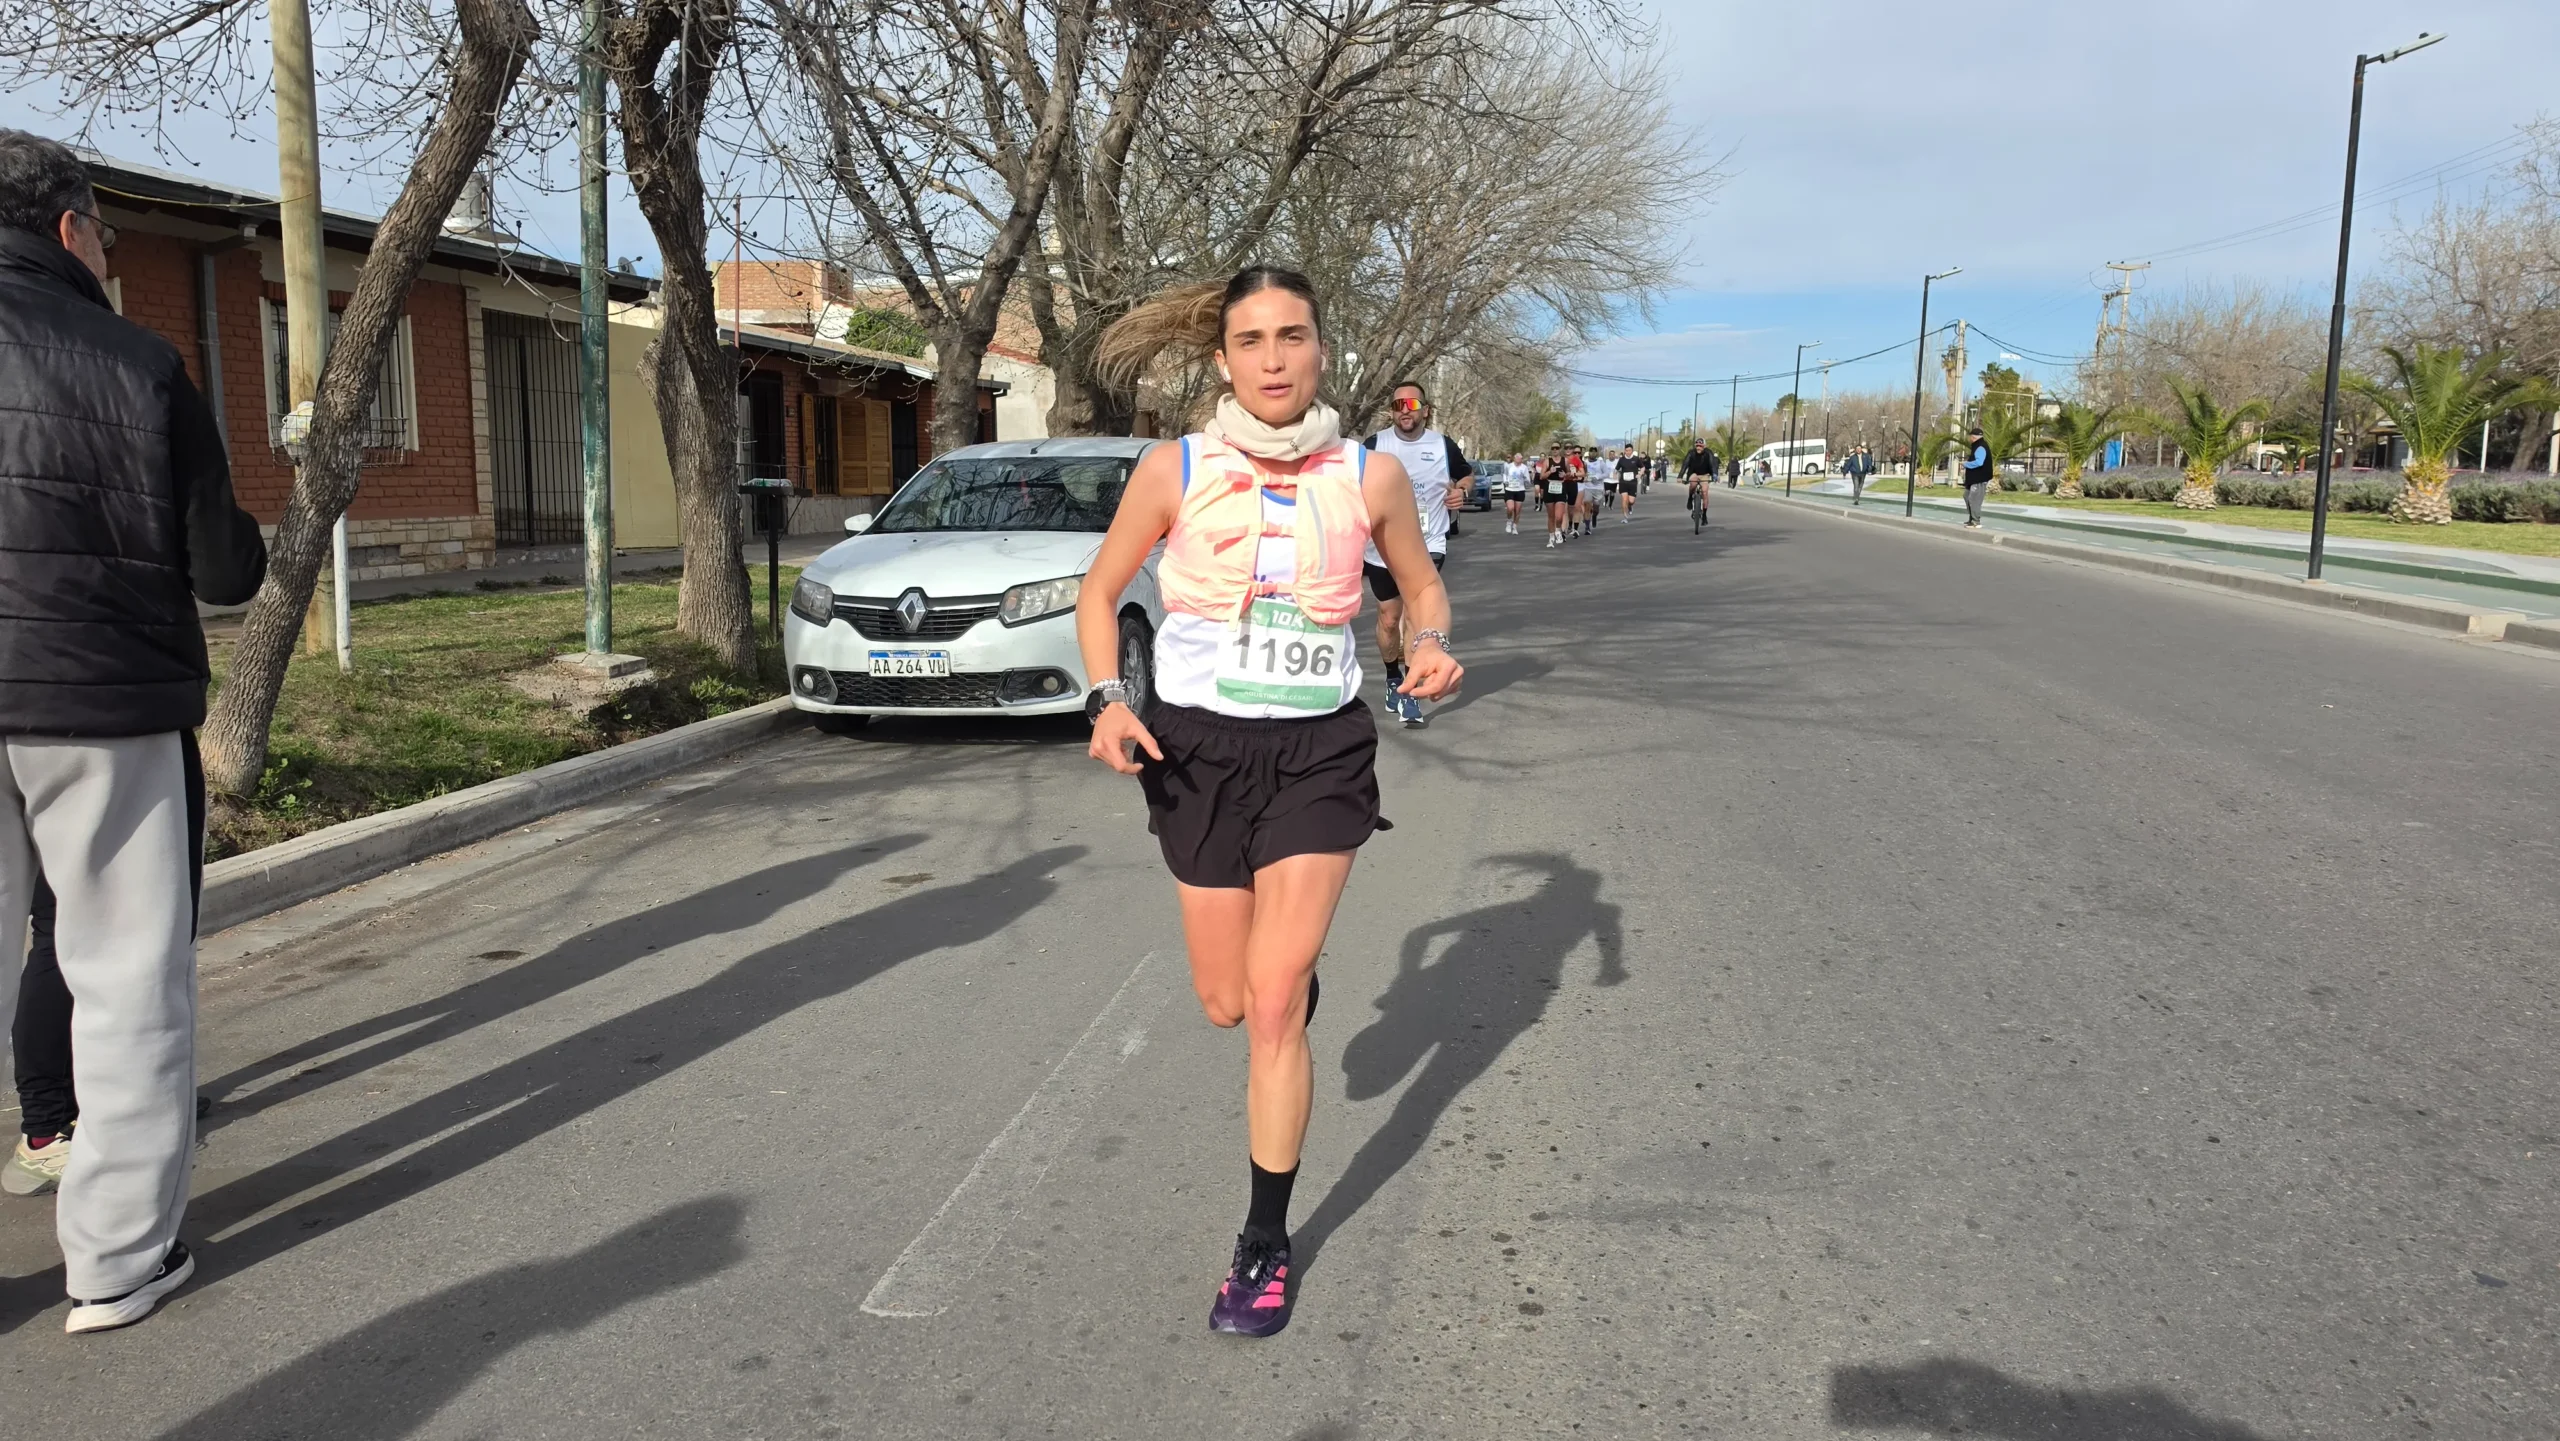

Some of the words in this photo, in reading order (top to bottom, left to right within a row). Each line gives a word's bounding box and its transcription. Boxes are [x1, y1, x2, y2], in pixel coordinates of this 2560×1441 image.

[1272, 609, 1305, 629] 10K
[1232, 634, 1335, 677] 1196
[873, 659, 891, 674] AA
[896, 659, 923, 674] 264
[928, 659, 946, 674] VU
[1243, 690, 1279, 700] AGUSTINA
